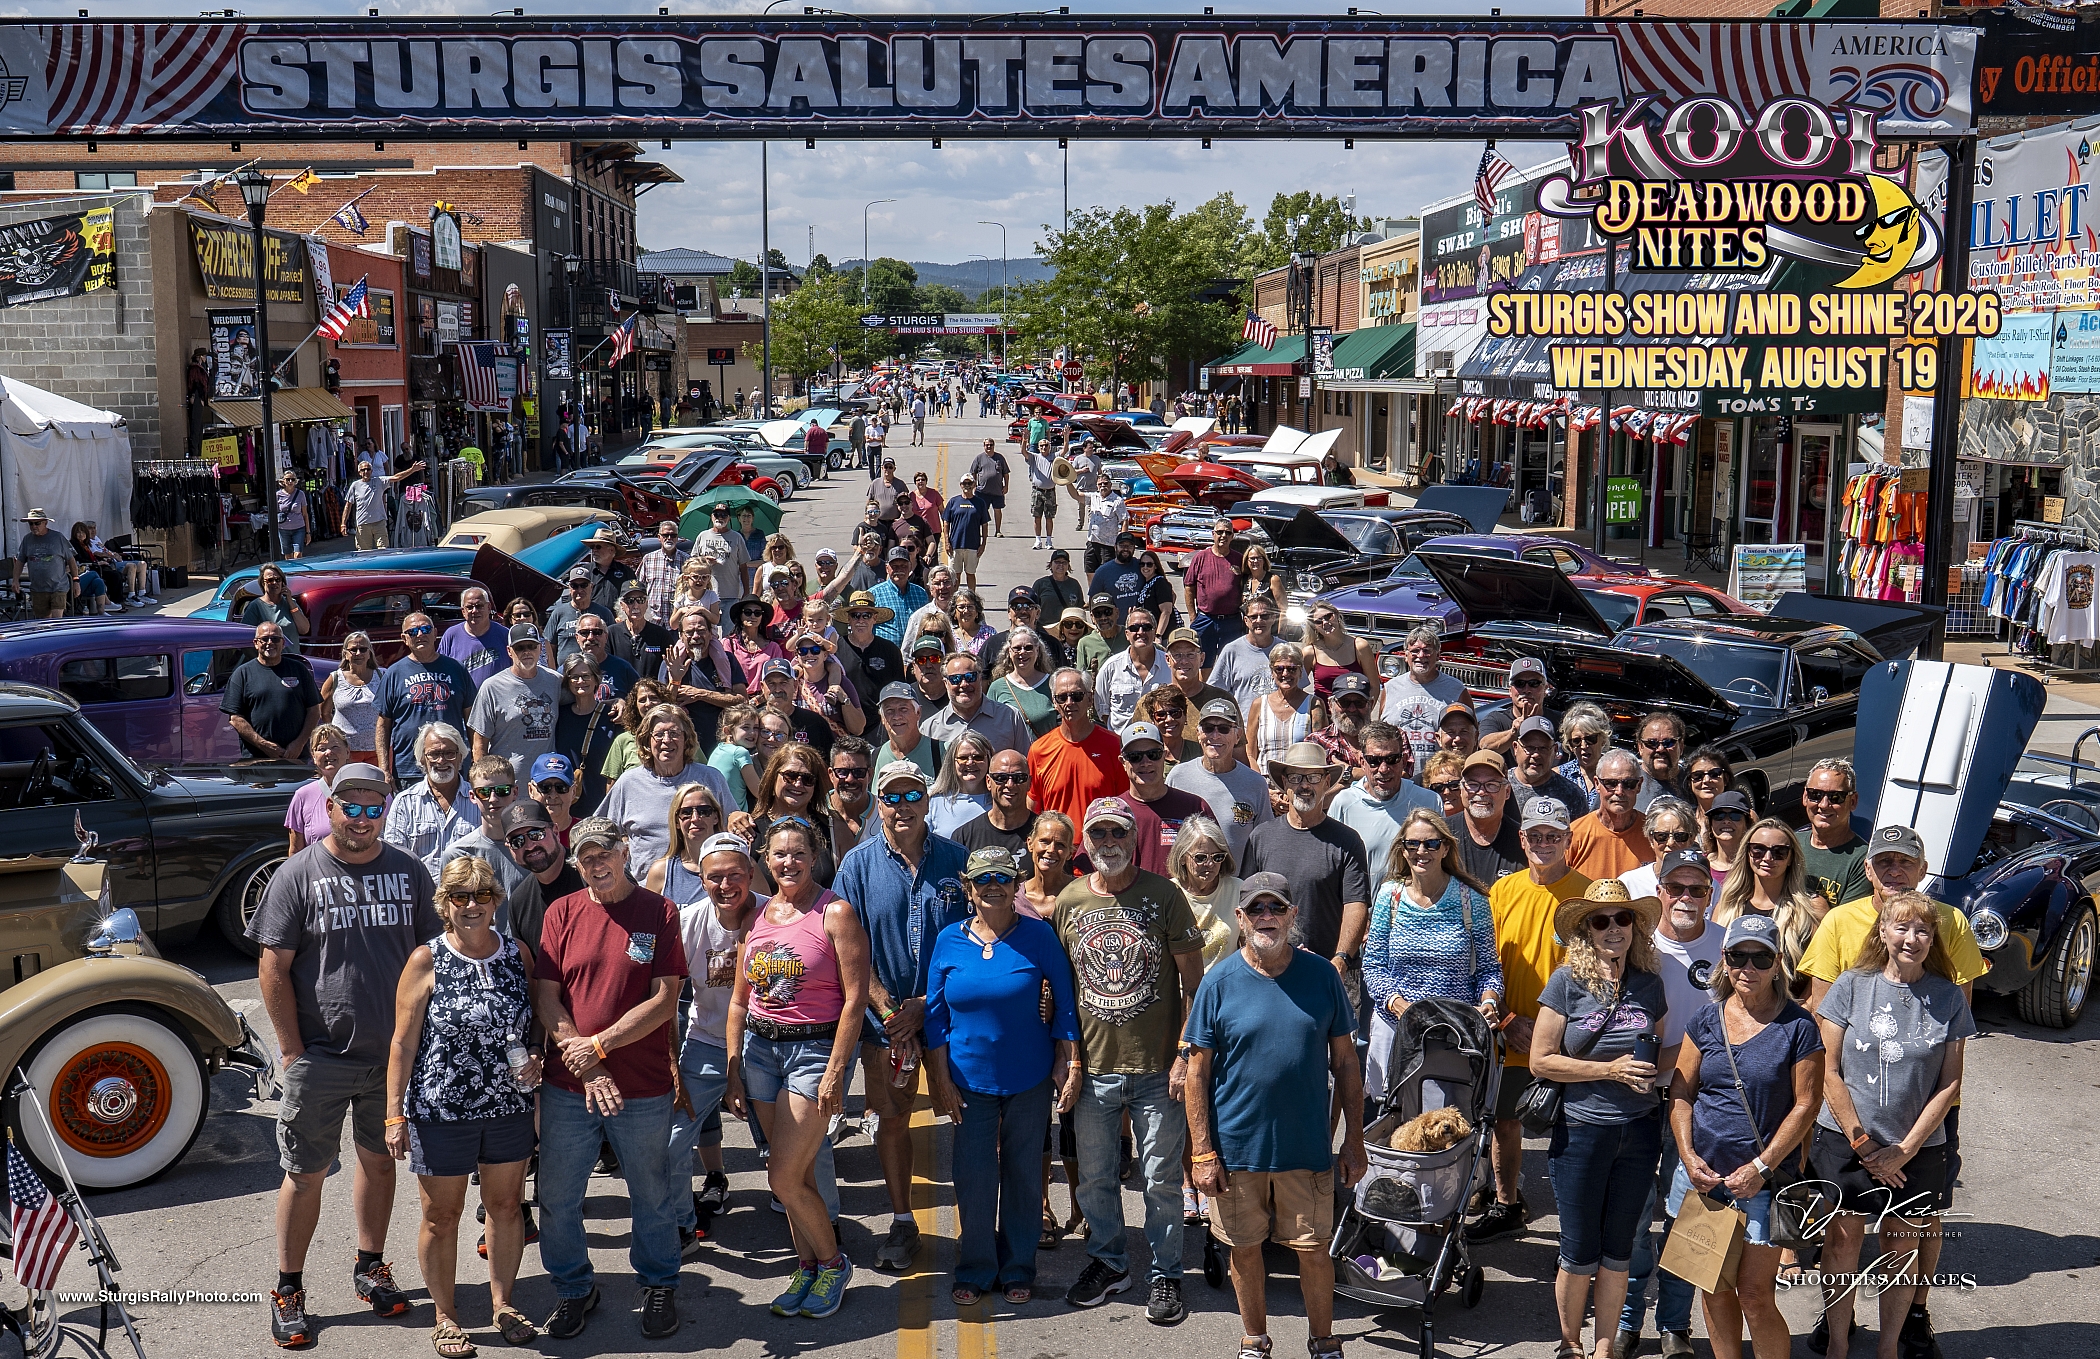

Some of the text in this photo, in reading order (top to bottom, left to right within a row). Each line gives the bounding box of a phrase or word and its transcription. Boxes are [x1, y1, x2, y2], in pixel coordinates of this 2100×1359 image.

[2041, 20, 2075, 32] CHAMBER
[1831, 35, 1949, 57] AMERICA
[242, 39, 1619, 109] STURGIS SALUTES AMERICA
[2014, 54, 2100, 94] Offici
[1829, 62, 1950, 122] 250
[1465, 205, 1482, 228] Big
[1969, 182, 2090, 250] ILLET
[14, 220, 54, 241] WILD
[1437, 231, 1475, 256] SWAP
[1360, 257, 1410, 283] GOLD PAN
[1970, 249, 2100, 278] Custom Billet Parts For
[2021, 280, 2040, 293] Shift
[2041, 280, 2062, 292] Rods,
[2064, 278, 2086, 290] Floor
[279, 289, 303, 302] APPAREL
[1369, 288, 1398, 317] PIZZA
[2011, 296, 2033, 308] Poles,
[2035, 294, 2055, 306] Head
[2056, 292, 2085, 306] Lights,
[212, 315, 251, 325] WELCOME TO
[889, 316, 938, 325] STURGIS
[2078, 312, 2100, 332] Ac
[897, 326, 911, 334] THIS
[932, 326, 944, 334] FOR
[945, 326, 958, 334] YOU
[959, 326, 985, 334] STURGIS
[2011, 328, 2050, 345] Rally T-Shirt
[214, 326, 233, 395] STURGIS
[560, 338, 569, 377] STURGIS
[2056, 355, 2066, 363] Shift
[2066, 356, 2084, 364] Linkages
[1064, 366, 1082, 376] STOP
[1333, 368, 1345, 379] PAN
[1345, 367, 1365, 379] PIZZA
[2060, 365, 2078, 373] Coolers,
[1644, 390, 1677, 408] RIDE BUCK
[1717, 395, 1817, 413] TOM'S T's
[1719, 431, 1728, 441] RIDE
[1719, 442, 1729, 452] BUCK
[1718, 452, 1730, 464] NAKED
[1607, 482, 1639, 492] ome in
[404, 671, 452, 687] AMERICA
[409, 682, 451, 704] 250
[1395, 695, 1447, 711] FREEDOM
[1405, 730, 1436, 743] BQ
[312, 872, 412, 907] IT'S FINE
[318, 902, 414, 933] I ZIP TIED IT
[1082, 910, 1106, 925] 1776
[1116, 908, 1143, 922] 2026
[1105, 937, 1121, 948] USA
[706, 949, 726, 957] Read
[752, 951, 805, 979] Sturgis
[705, 979, 736, 989] Mag
[1085, 987, 1152, 1007] WE THE PEOPLE
[1686, 1228, 1717, 1250] BHR&G
